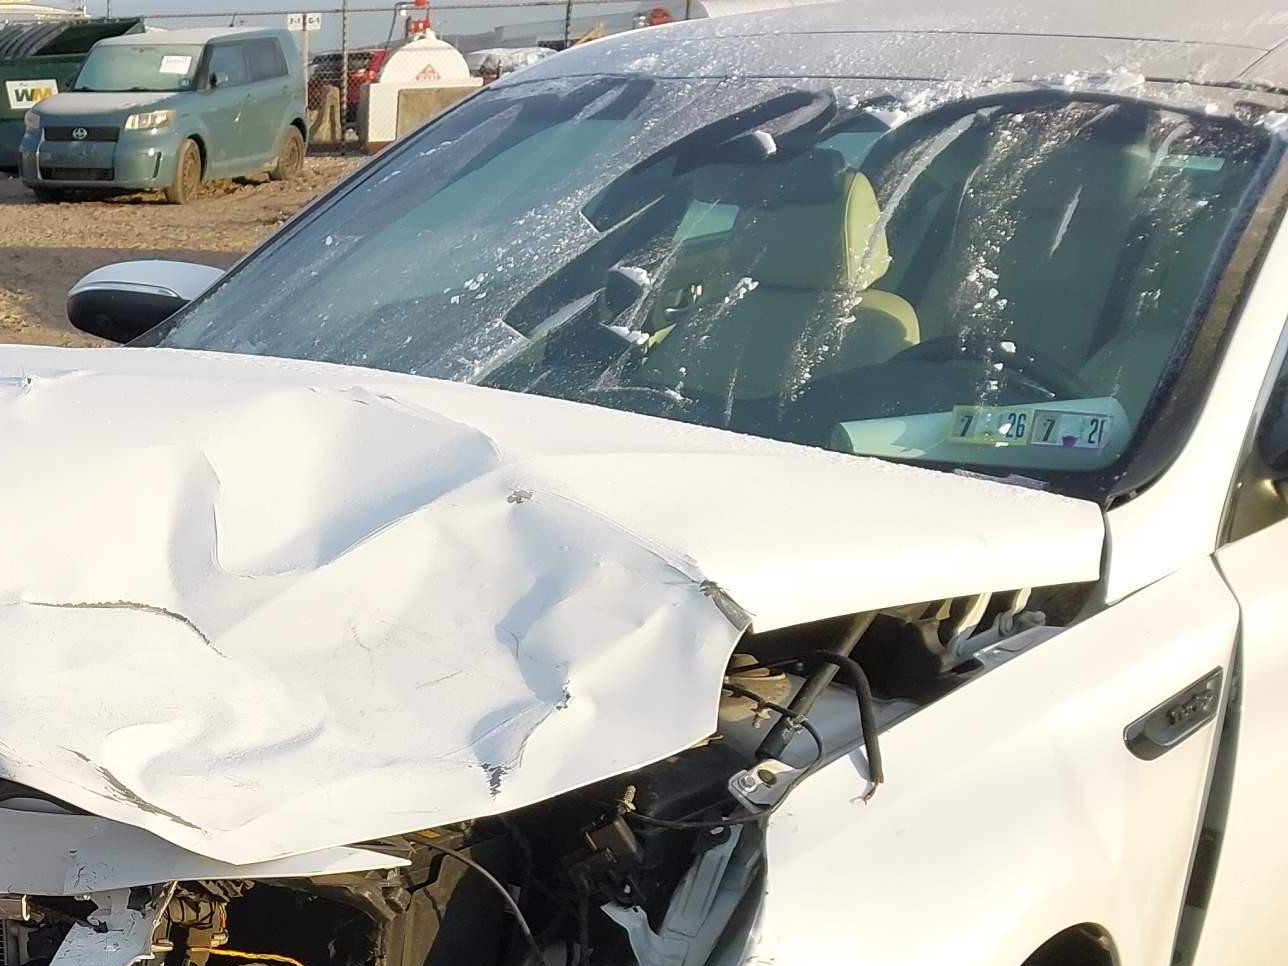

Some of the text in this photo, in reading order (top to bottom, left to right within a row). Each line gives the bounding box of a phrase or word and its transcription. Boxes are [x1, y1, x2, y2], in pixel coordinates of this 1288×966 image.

[14, 87, 53, 102] WM
[961, 412, 1027, 438] 7 26
[1043, 418, 1056, 442] 7
